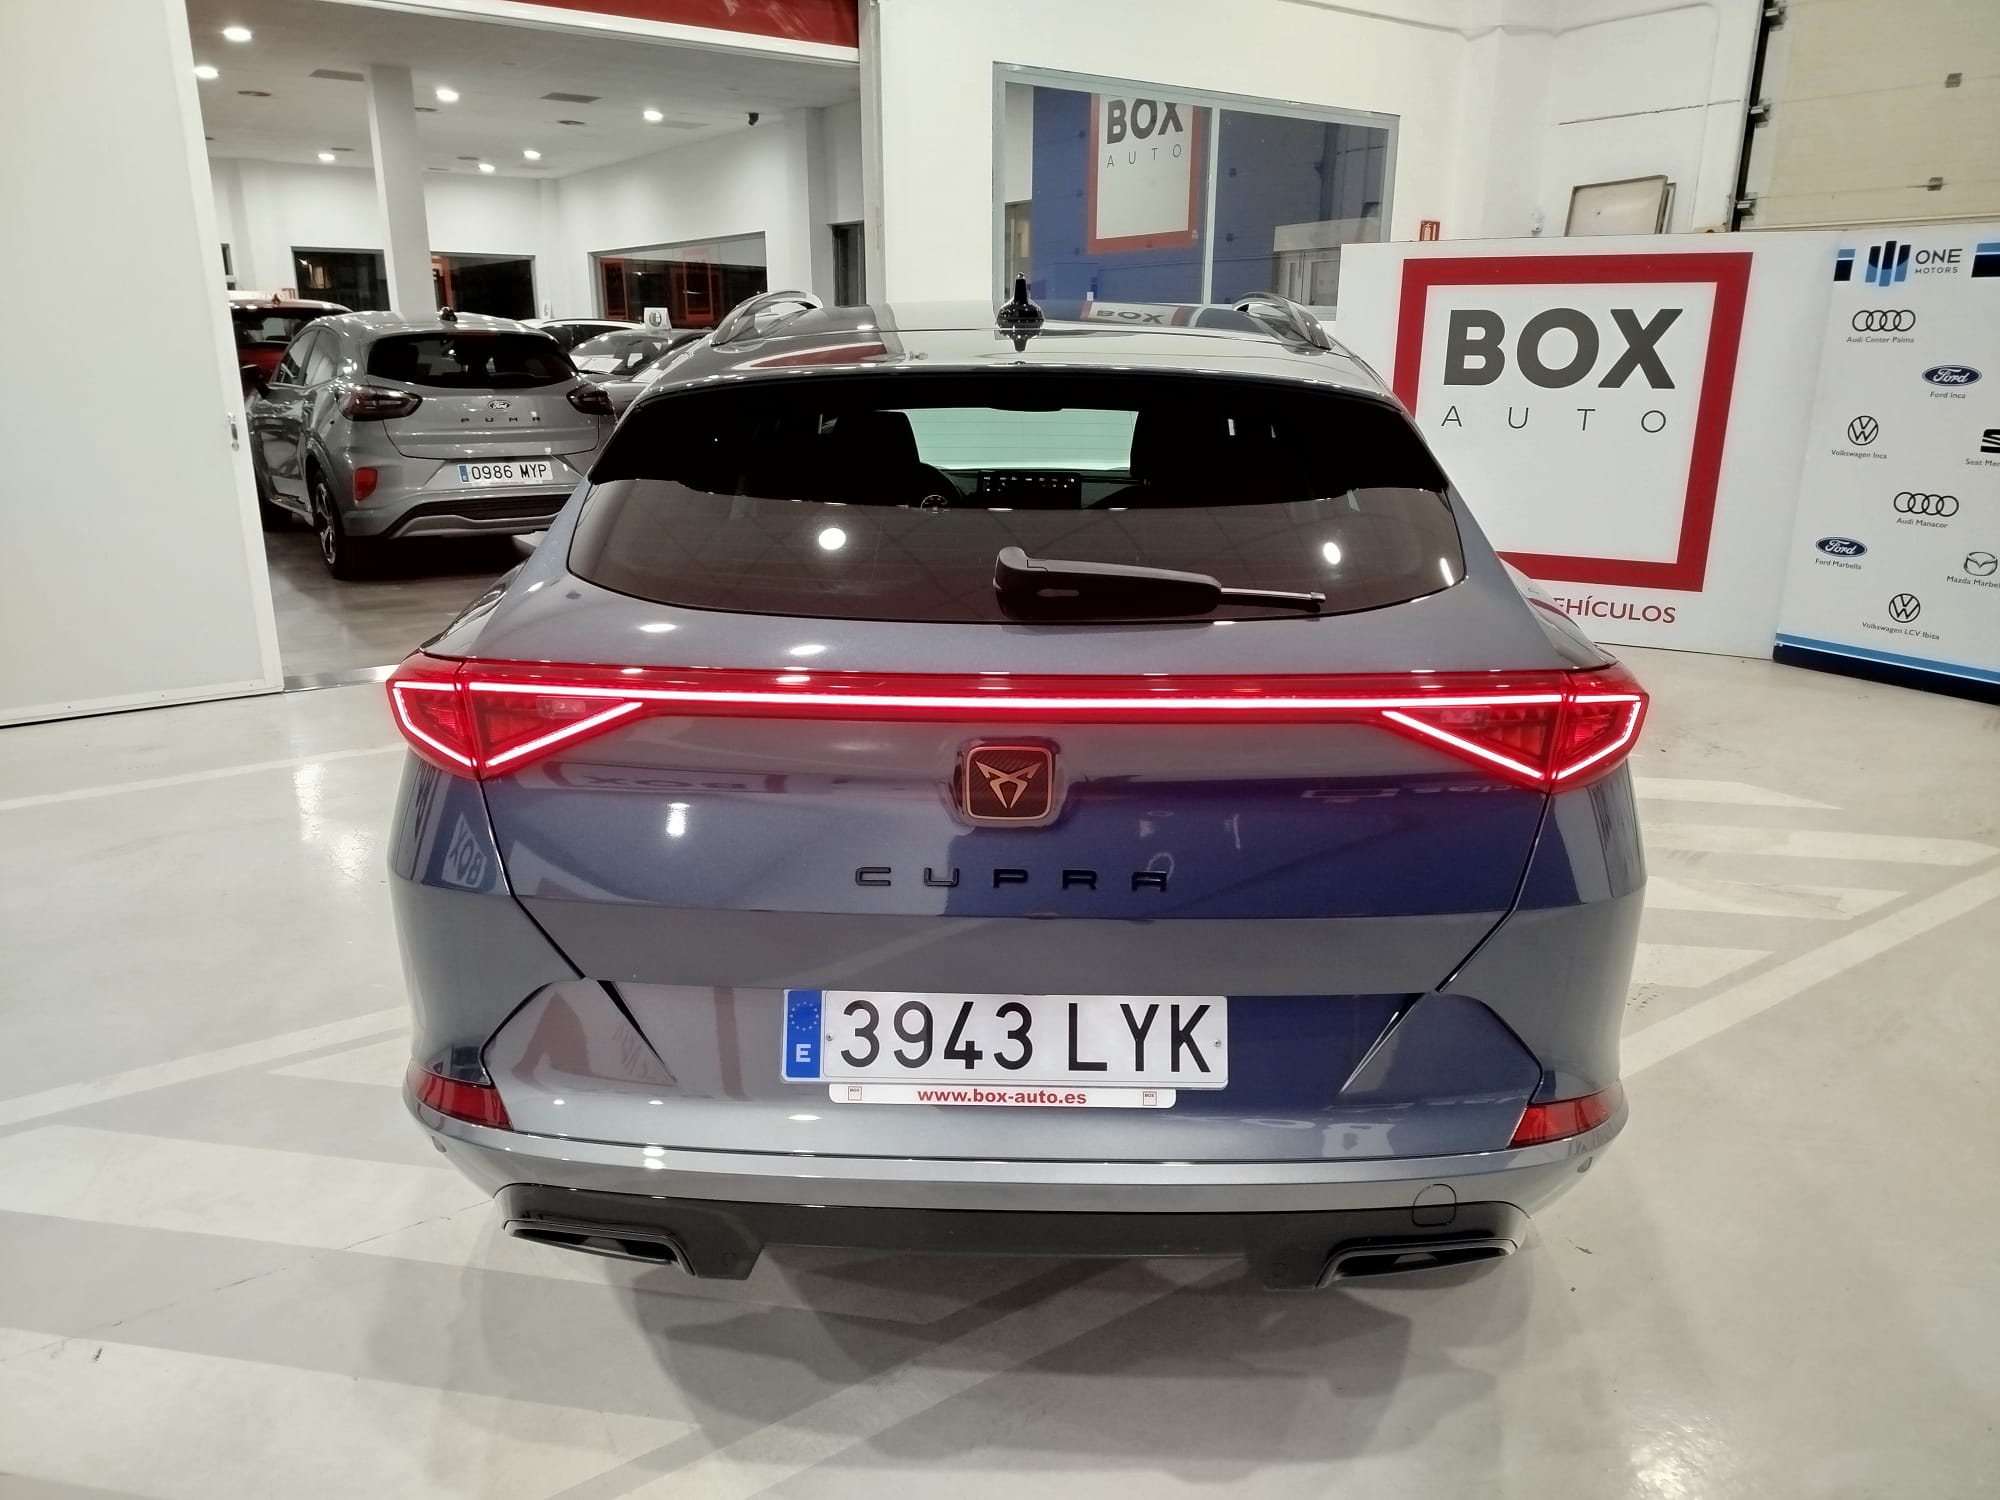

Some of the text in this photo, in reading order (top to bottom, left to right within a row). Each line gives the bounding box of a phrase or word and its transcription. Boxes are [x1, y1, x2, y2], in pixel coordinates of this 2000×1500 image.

[1107, 98, 1184, 144] BOX
[1106, 144, 1182, 169] AUTO
[1915, 248, 1963, 265] ONE
[1915, 266, 1958, 274] MOTORS
[1846, 336, 1915, 344] Audi Center Palma
[1443, 307, 1684, 390] BOX
[1932, 368, 1969, 384] Ford
[1930, 391, 1966, 399] Ford Inca
[1440, 405, 1667, 433] AUTO
[1831, 449, 1888, 460] Volkswagen Inca
[471, 464, 547, 480] 0986 MYP
[1896, 517, 1949, 529] Audi Manacor
[1824, 540, 1857, 555] Ford
[1815, 558, 1862, 570] Ford Marbella
[1946, 575, 1971, 586] Mazda
[1862, 622, 1940, 640] Volkswagen LCV Ibiza
[855, 866, 1169, 891] CUPRA
[795, 999, 1212, 1073] E 3943 LYK
[917, 1088, 1087, 1105] www.box-auto.es
